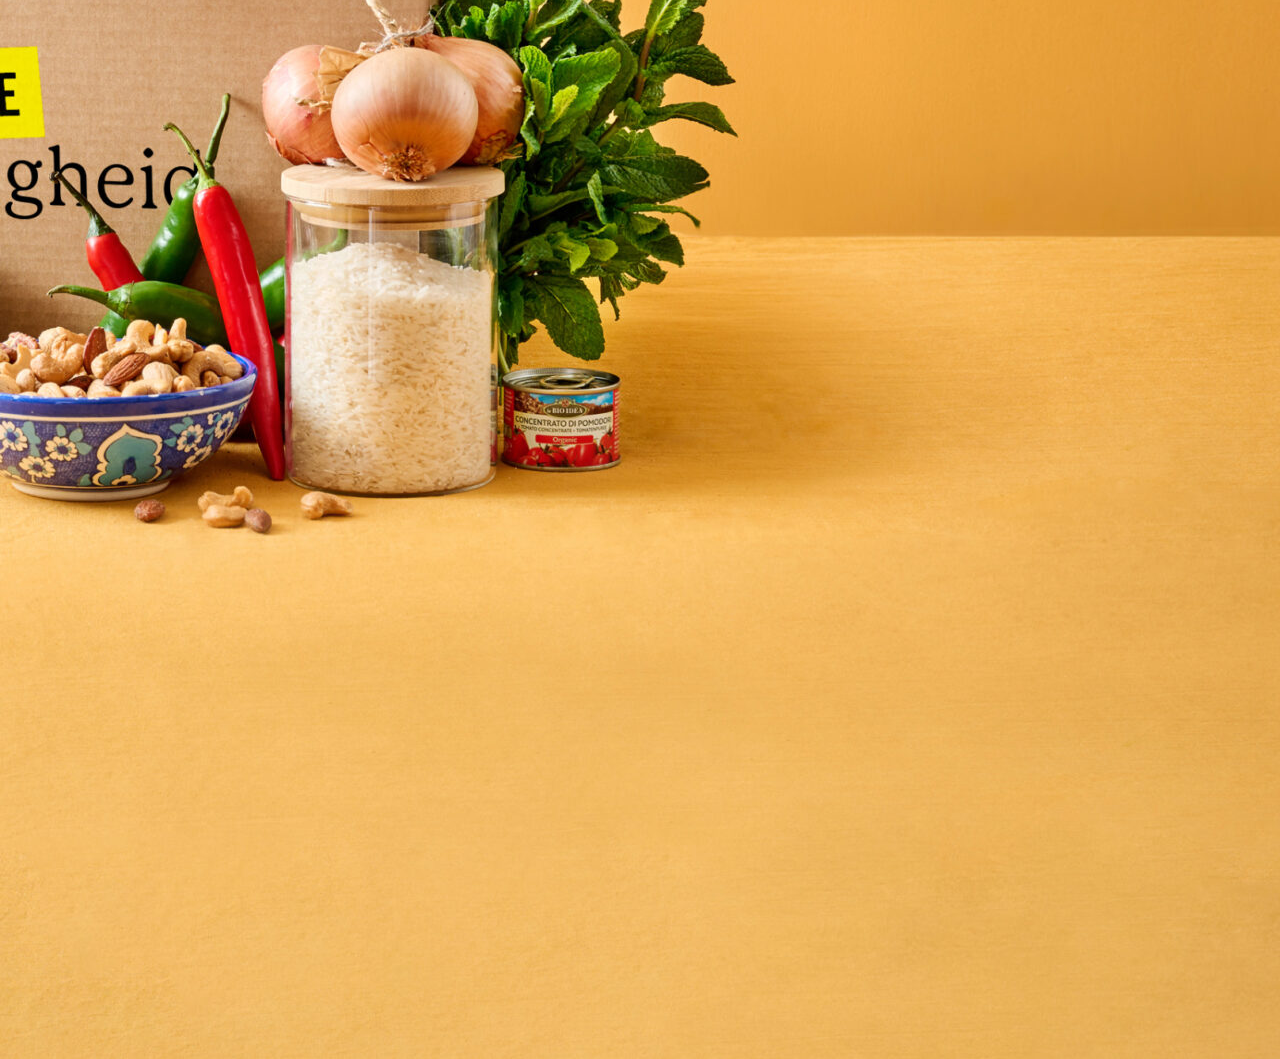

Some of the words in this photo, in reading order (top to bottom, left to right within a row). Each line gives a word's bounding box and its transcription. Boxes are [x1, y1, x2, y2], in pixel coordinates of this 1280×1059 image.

[515, 415, 567, 428] CONCENTRATO
[568, 419, 577, 428] DI
[577, 416, 612, 427] POMODORI
[552, 436, 577, 444] Organic
